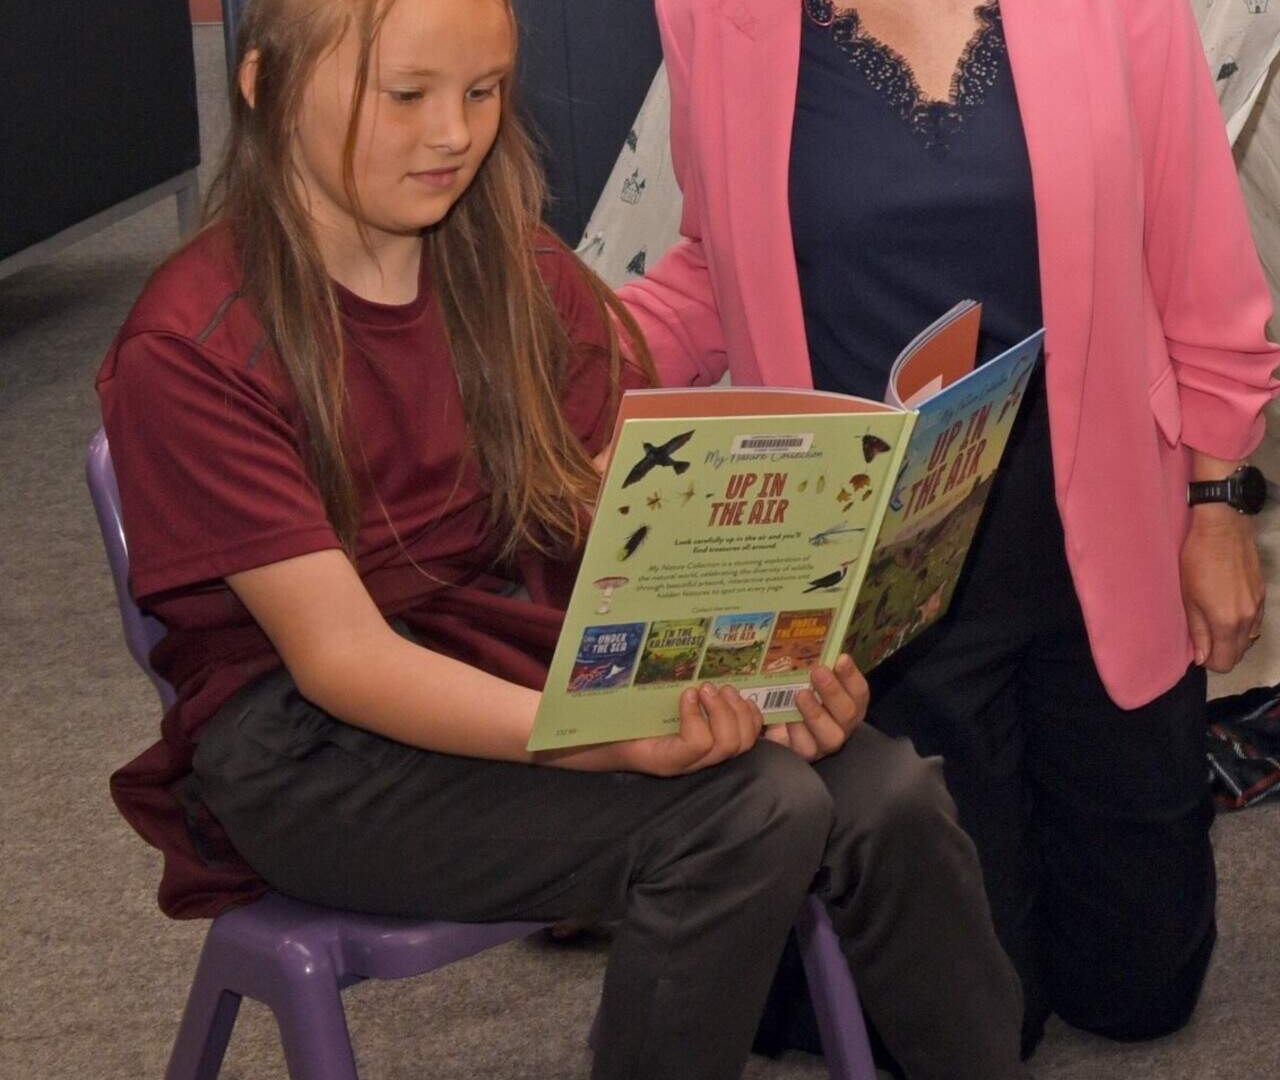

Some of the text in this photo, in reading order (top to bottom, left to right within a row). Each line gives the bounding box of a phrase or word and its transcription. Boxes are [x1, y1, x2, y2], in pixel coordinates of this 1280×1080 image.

[927, 401, 993, 472] UP IN
[725, 472, 789, 500] UP IN
[902, 437, 988, 522] THE AIR
[708, 498, 790, 527] THE AIR
[597, 632, 628, 645] UNDER
